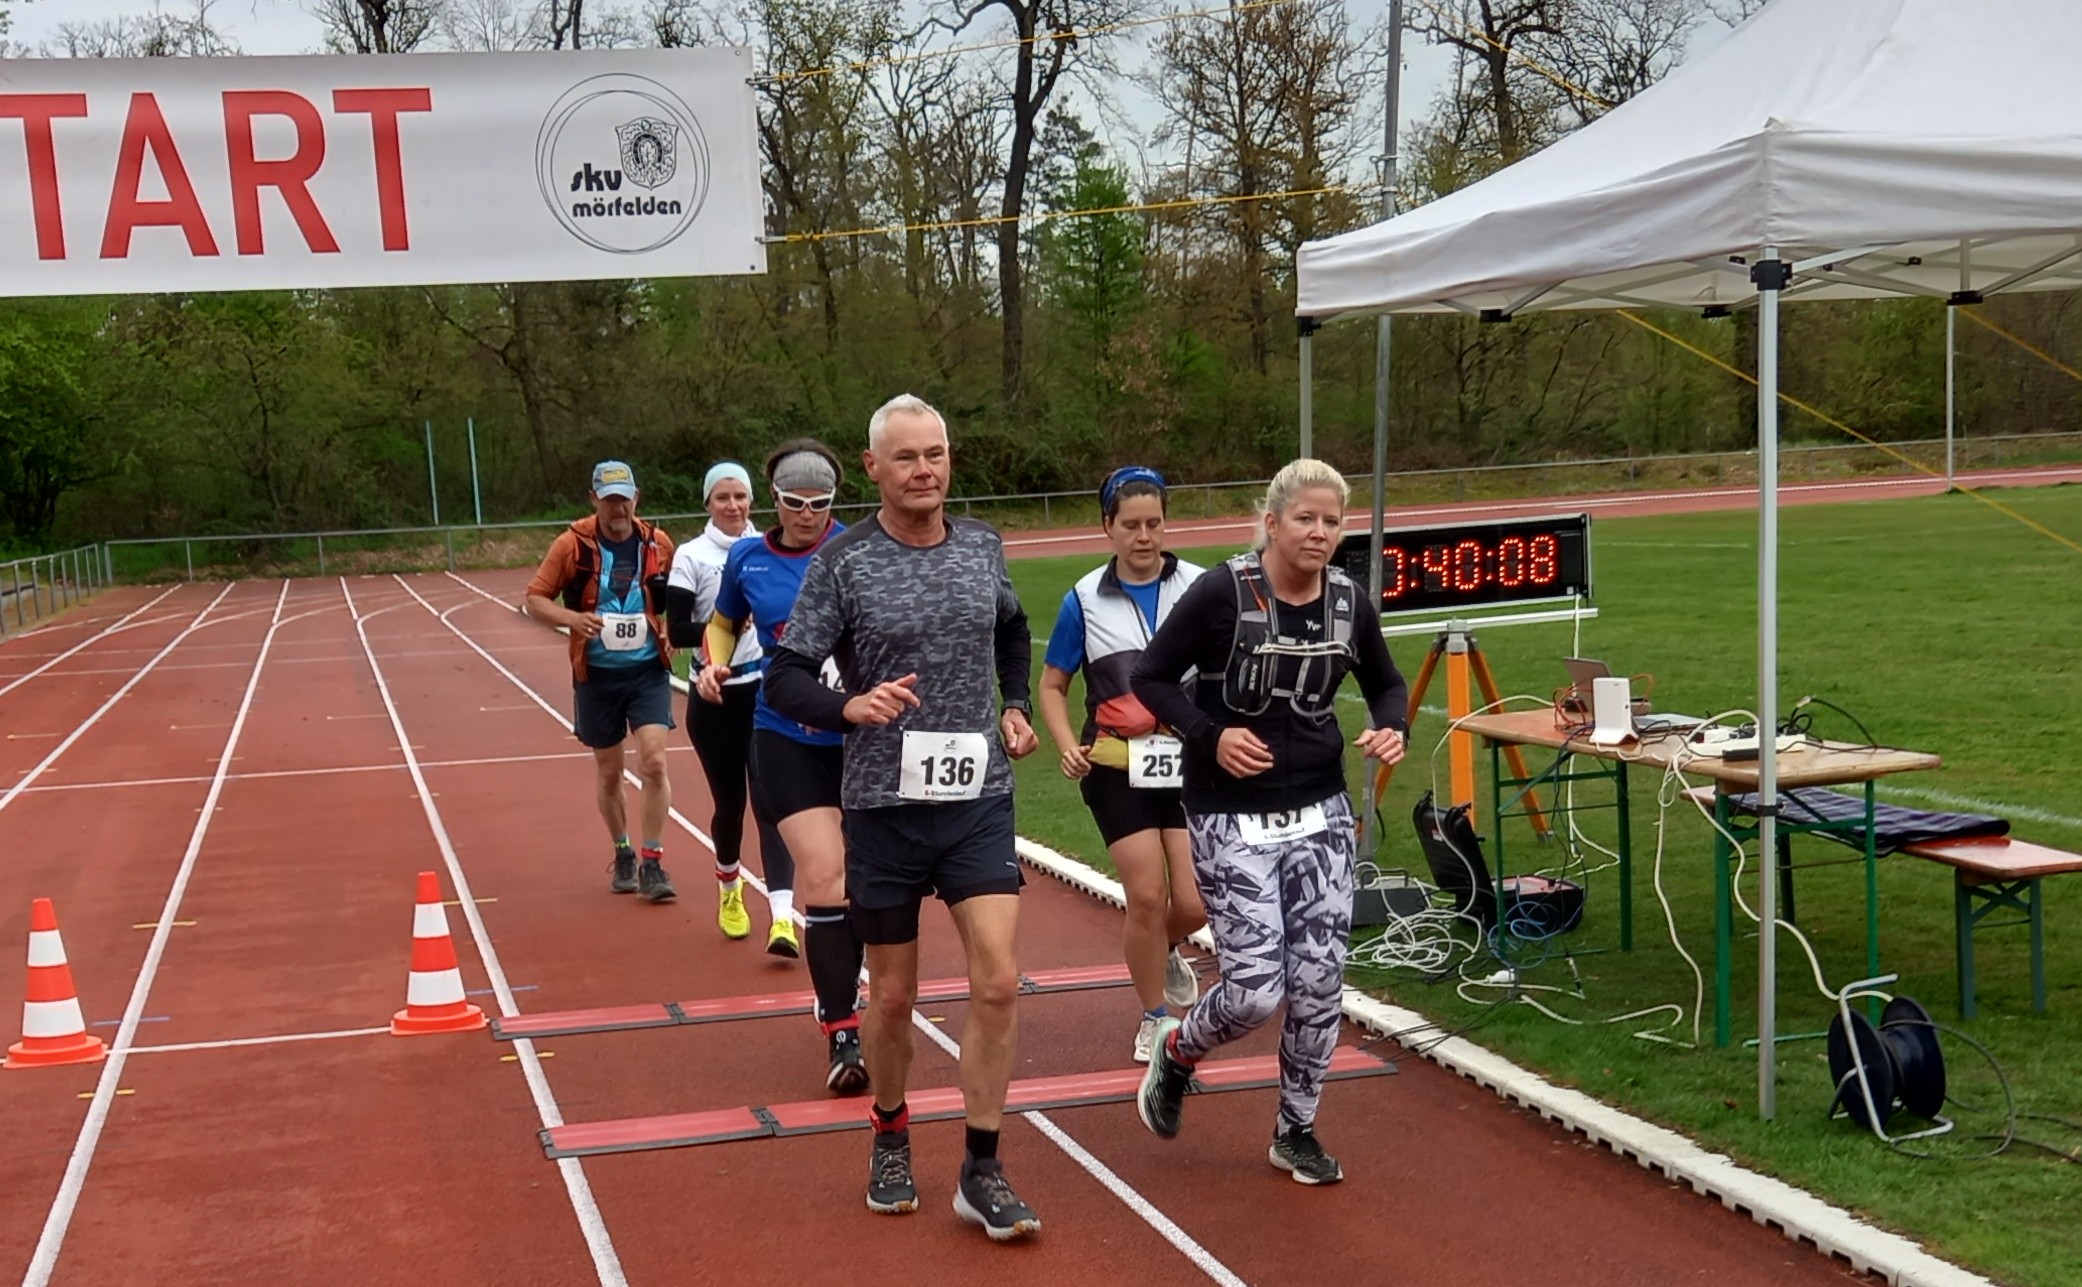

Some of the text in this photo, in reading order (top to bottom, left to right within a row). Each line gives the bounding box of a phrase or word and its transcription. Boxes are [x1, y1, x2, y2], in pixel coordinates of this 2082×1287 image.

[571, 162, 622, 192] skv
[572, 197, 682, 217] mörfelden
[615, 622, 637, 638] 88
[920, 756, 975, 786] 136
